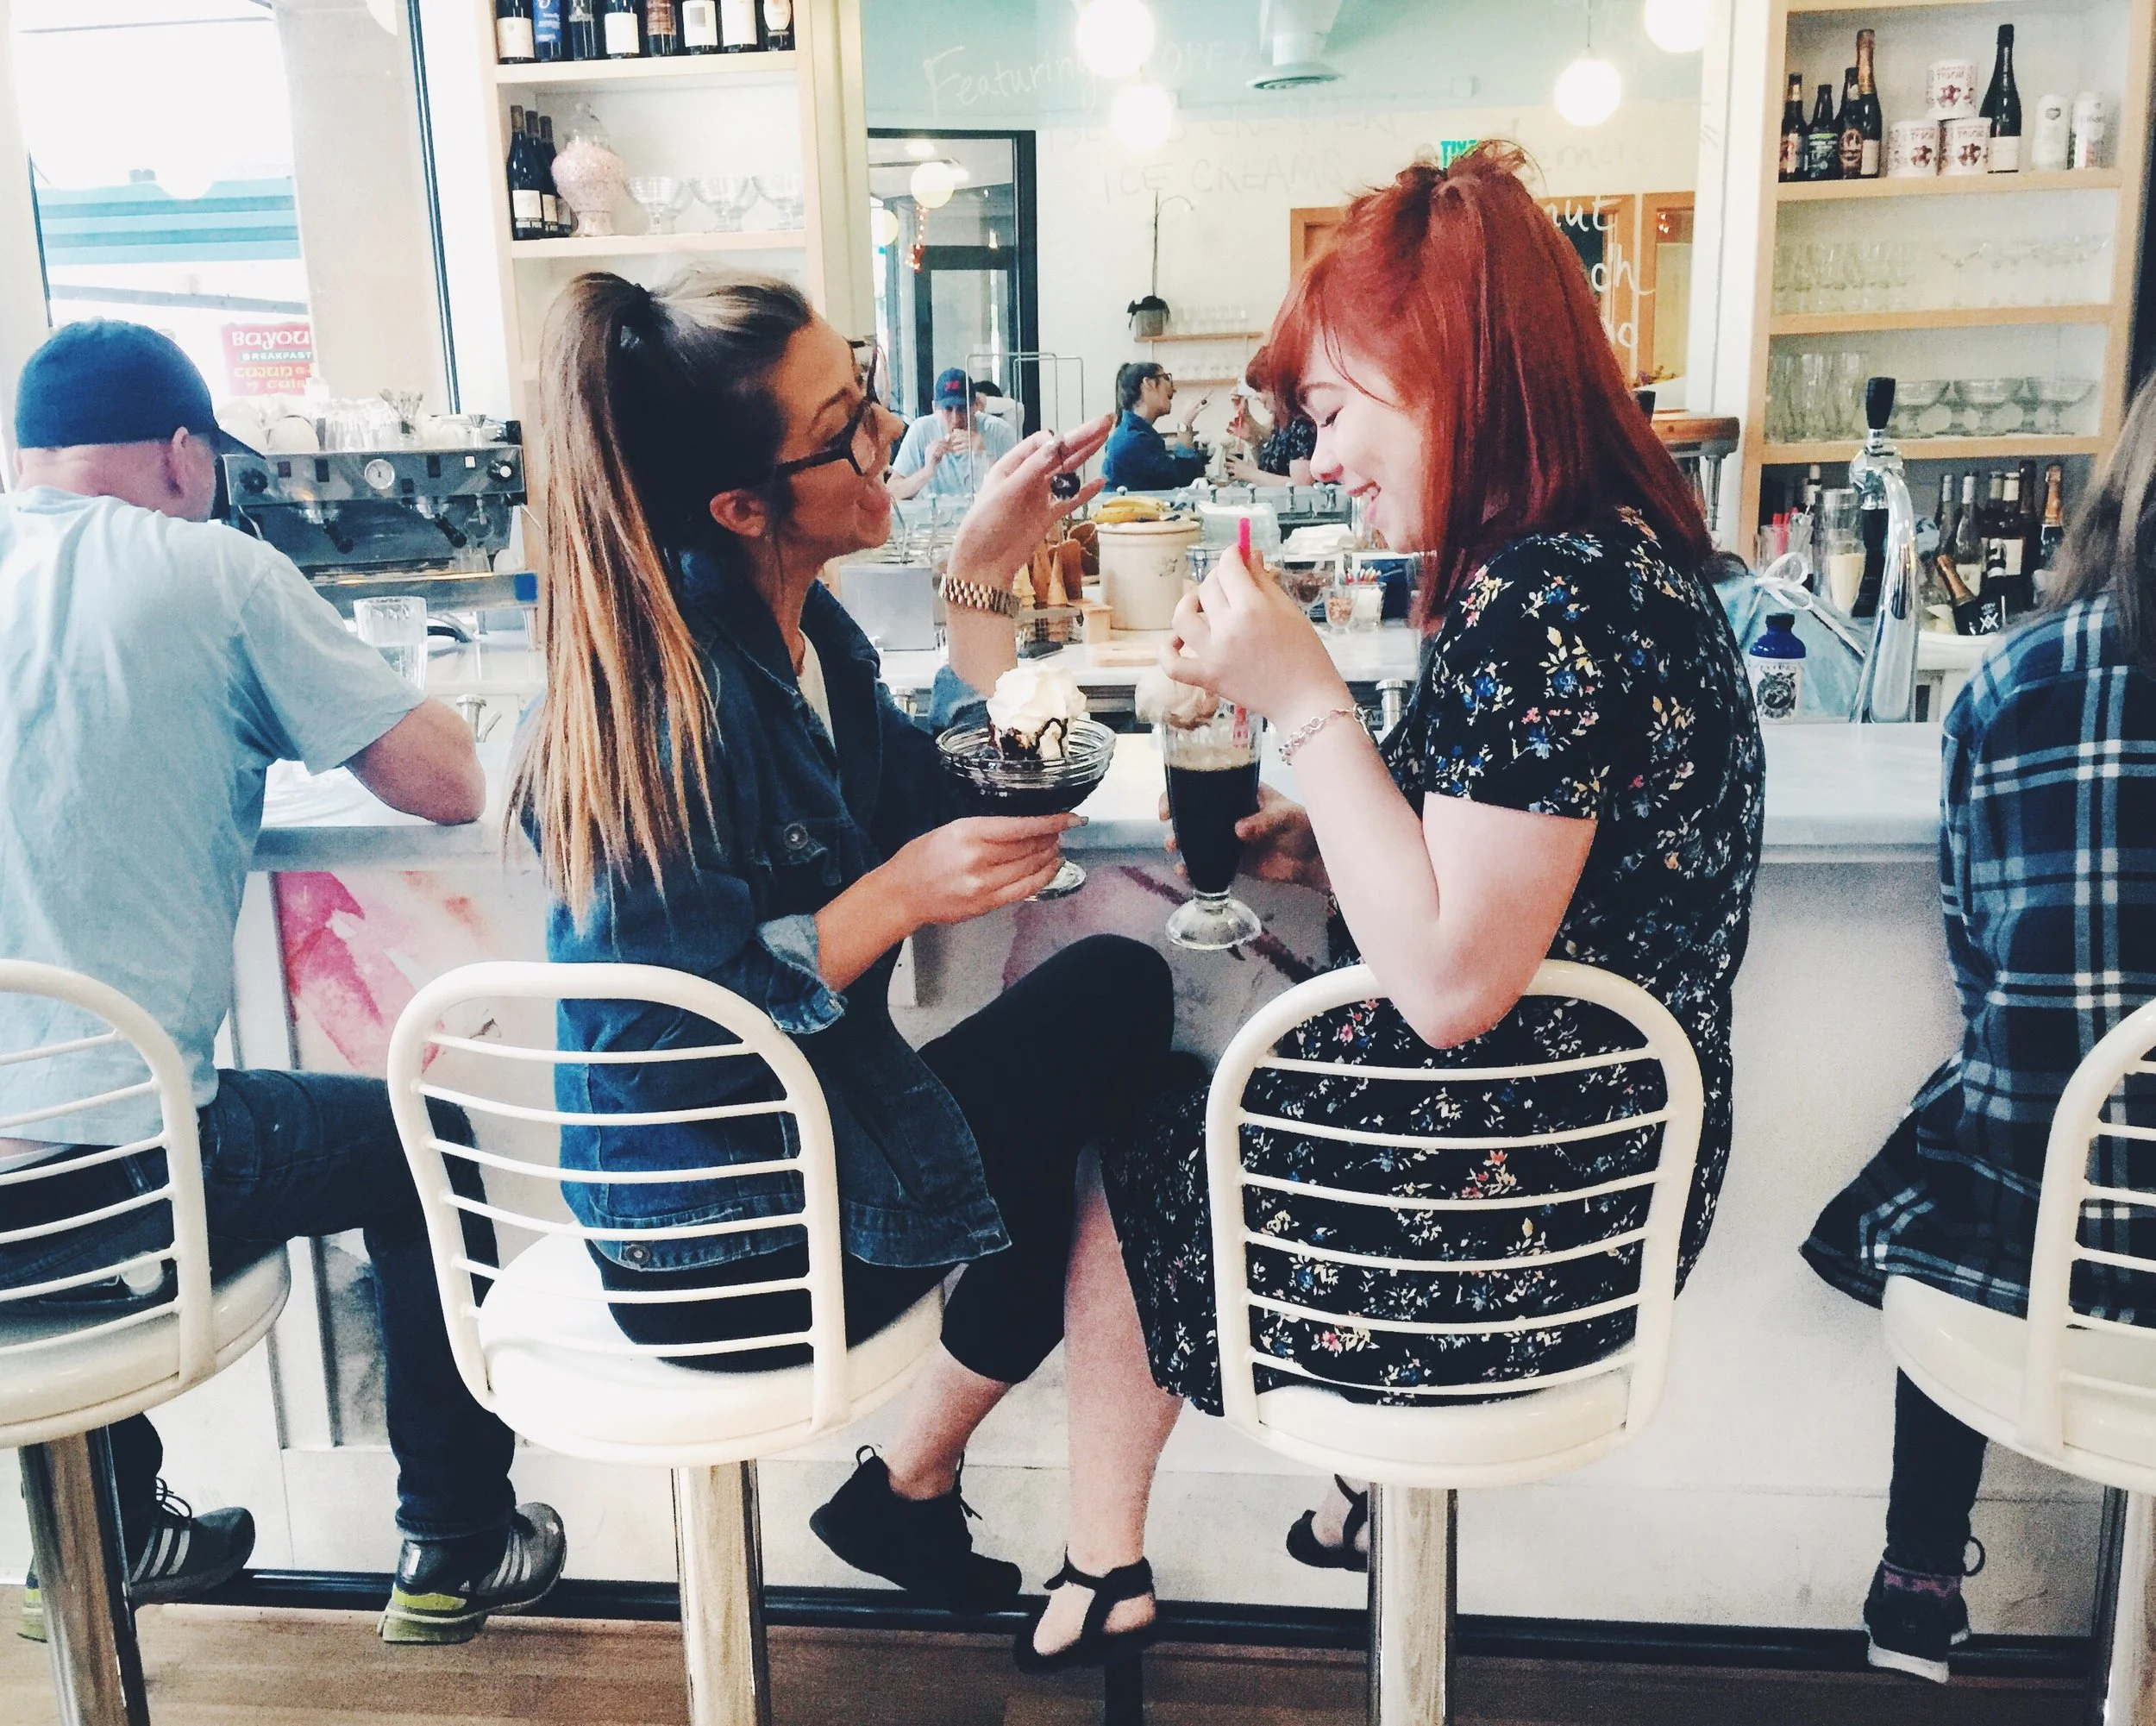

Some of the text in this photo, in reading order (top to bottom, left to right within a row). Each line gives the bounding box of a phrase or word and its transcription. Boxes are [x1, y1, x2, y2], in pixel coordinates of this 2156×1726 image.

[1104, 147, 1343, 204] ICE CREAMS
[231, 330, 310, 350] Bayou
[242, 351, 311, 361] BREAKFAST
